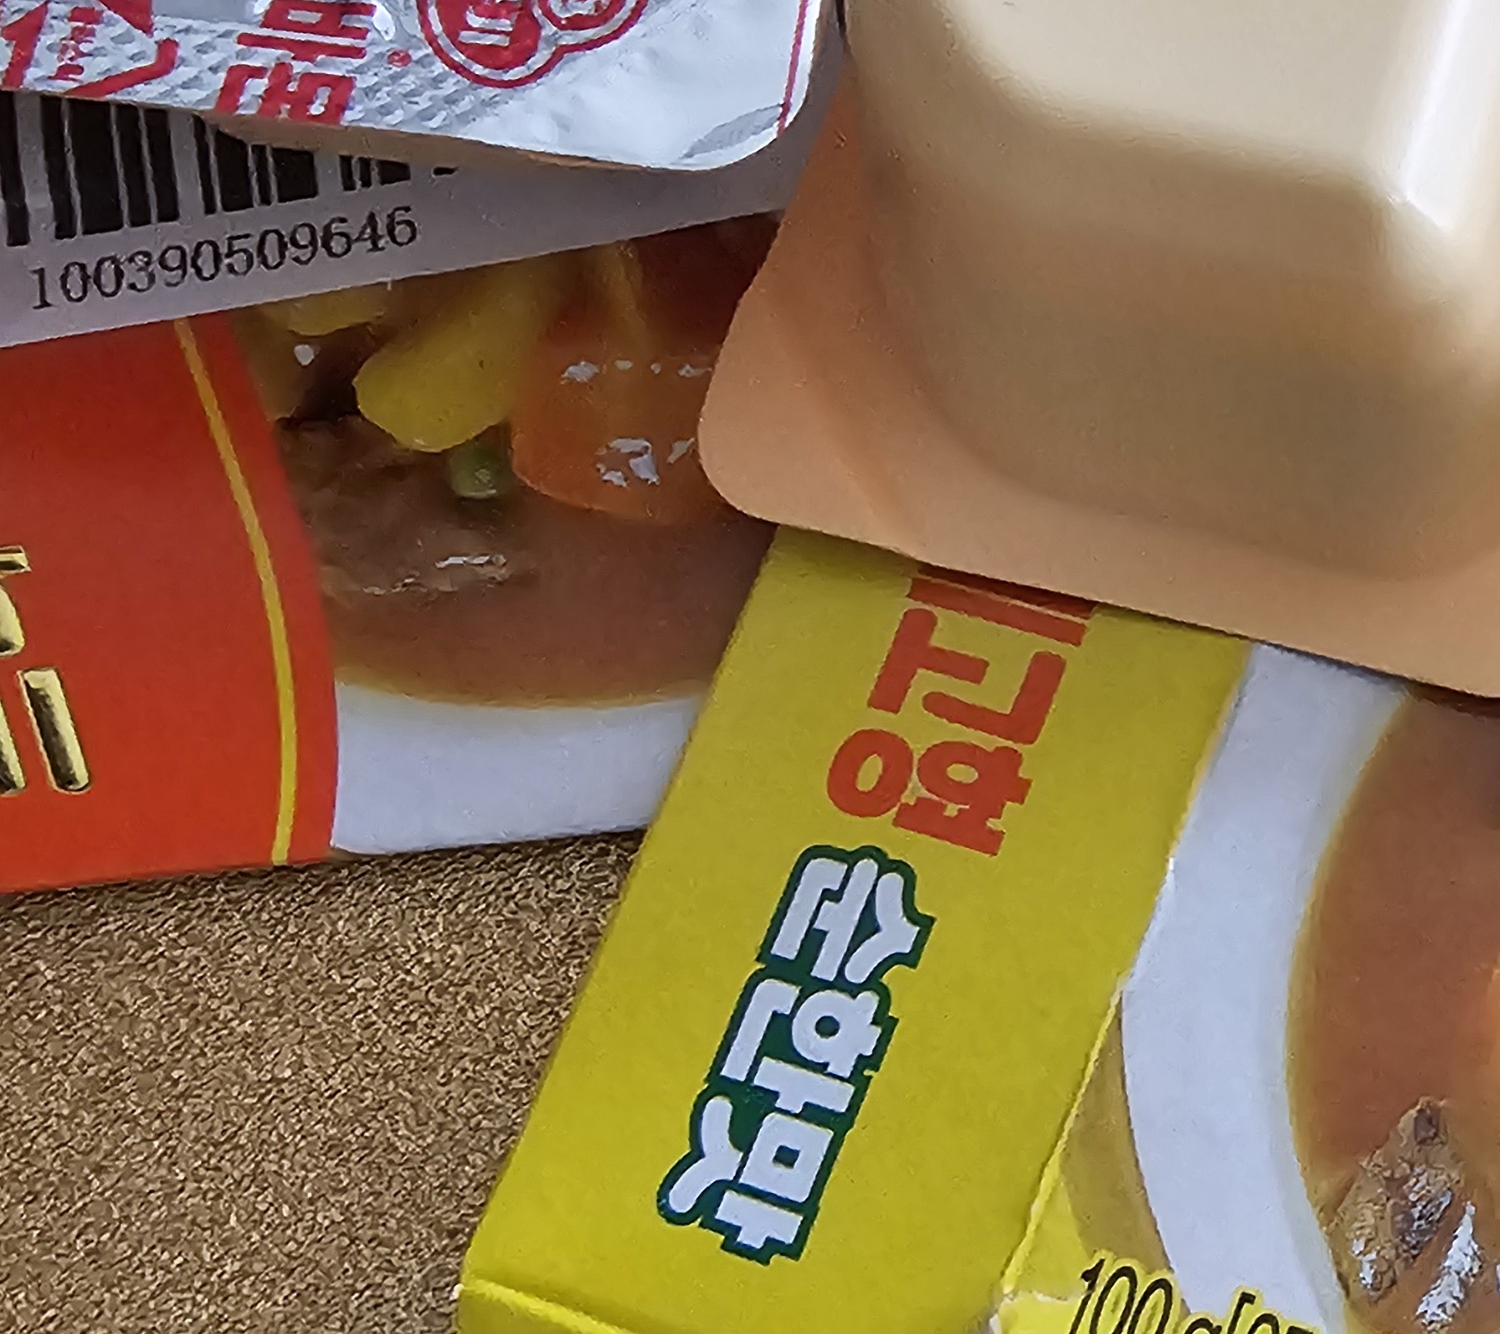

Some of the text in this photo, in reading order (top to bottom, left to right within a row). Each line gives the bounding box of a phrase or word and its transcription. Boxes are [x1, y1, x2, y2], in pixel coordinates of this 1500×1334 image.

[31, 205, 419, 311] 100390509646
[826, 569, 1099, 857] 고형
[662, 849, 930, 1261] 순한맛
